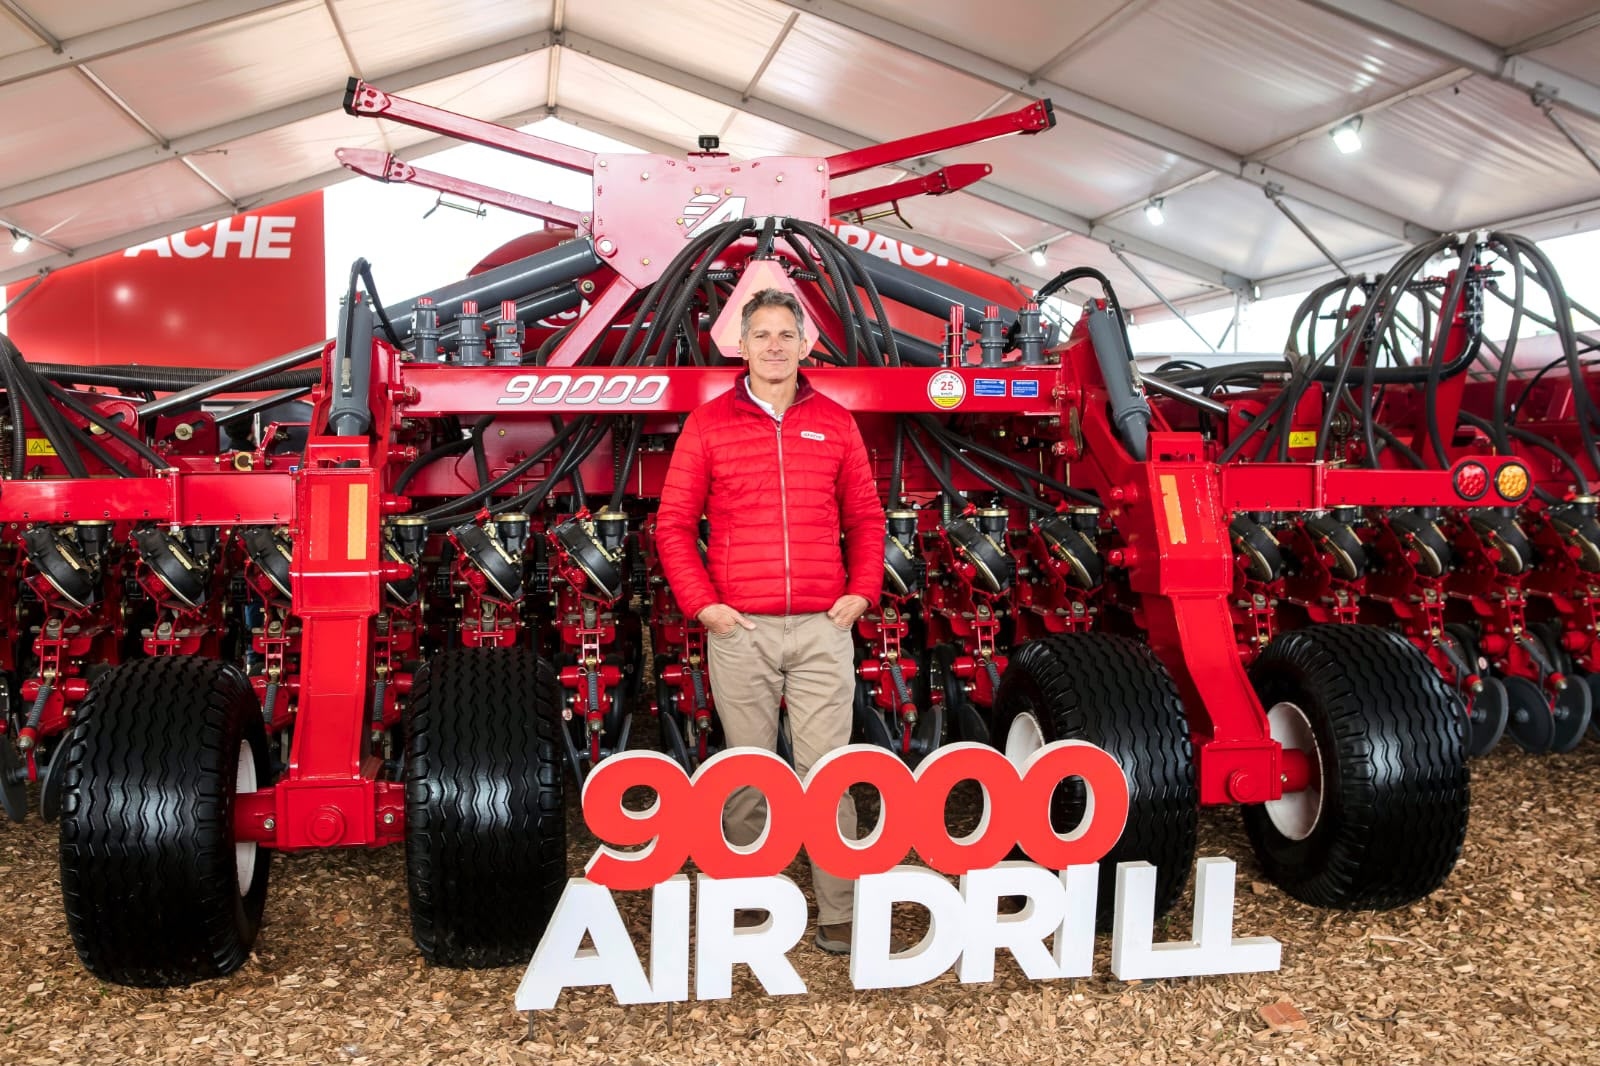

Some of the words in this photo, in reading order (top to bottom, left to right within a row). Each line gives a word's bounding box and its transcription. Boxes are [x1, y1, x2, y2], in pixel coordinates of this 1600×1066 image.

[829, 224, 949, 267] PAC
[496, 375, 670, 405] 90000
[940, 381, 954, 391] 25
[581, 740, 1130, 891] 90000
[514, 872, 808, 1011] AIR
[849, 856, 1282, 990] DRILL
